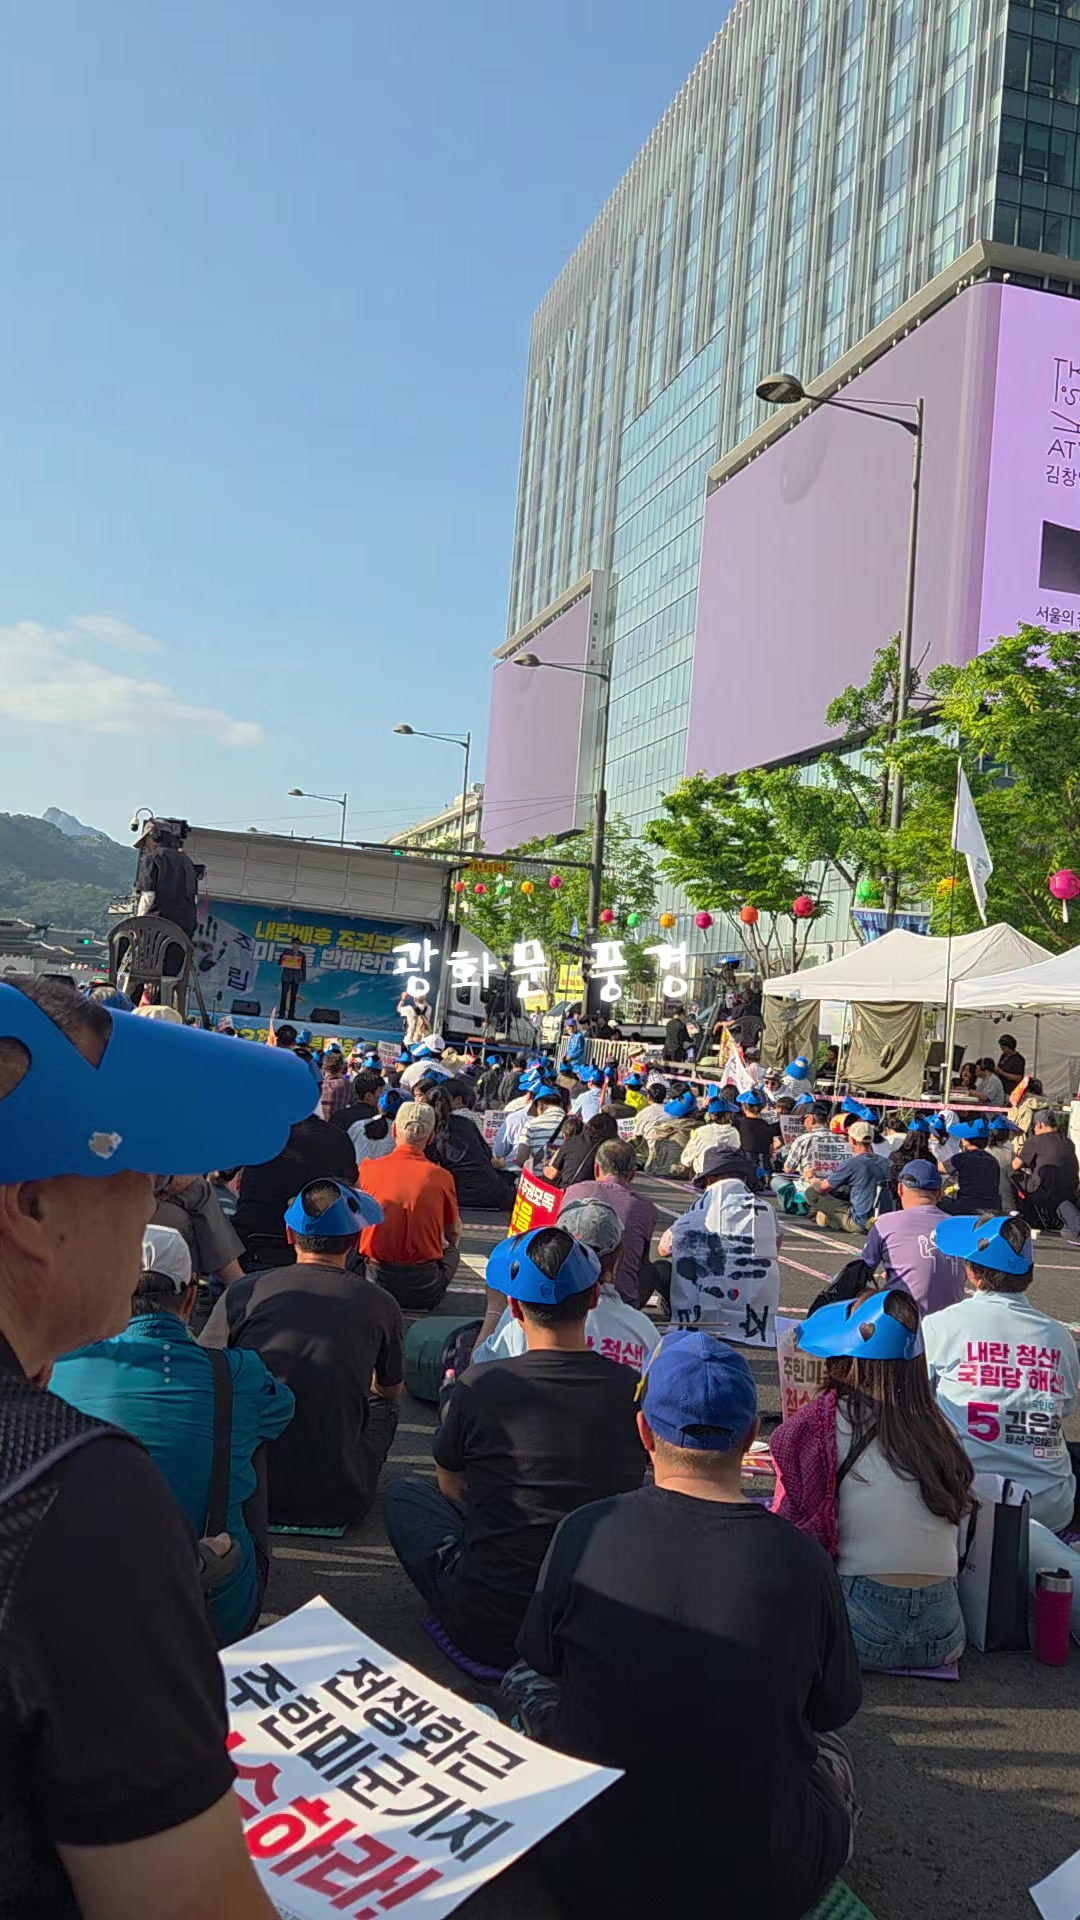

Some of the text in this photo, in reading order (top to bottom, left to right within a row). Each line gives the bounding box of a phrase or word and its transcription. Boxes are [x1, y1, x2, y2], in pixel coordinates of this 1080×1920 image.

[1046, 465, 1080, 486] 김창
[1036, 605, 1074, 626] 서울의
[255, 920, 333, 947] 내란배후
[967, 1341, 1061, 1371] 내란 청산!
[957, 1364, 1023, 1389] 국힘당
[967, 1401, 1000, 1443] 5
[320, 1657, 527, 1793] 전쟁화근
[229, 1662, 516, 1863] 주한미군기지
[225, 1730, 444, 1920] 수하라!
